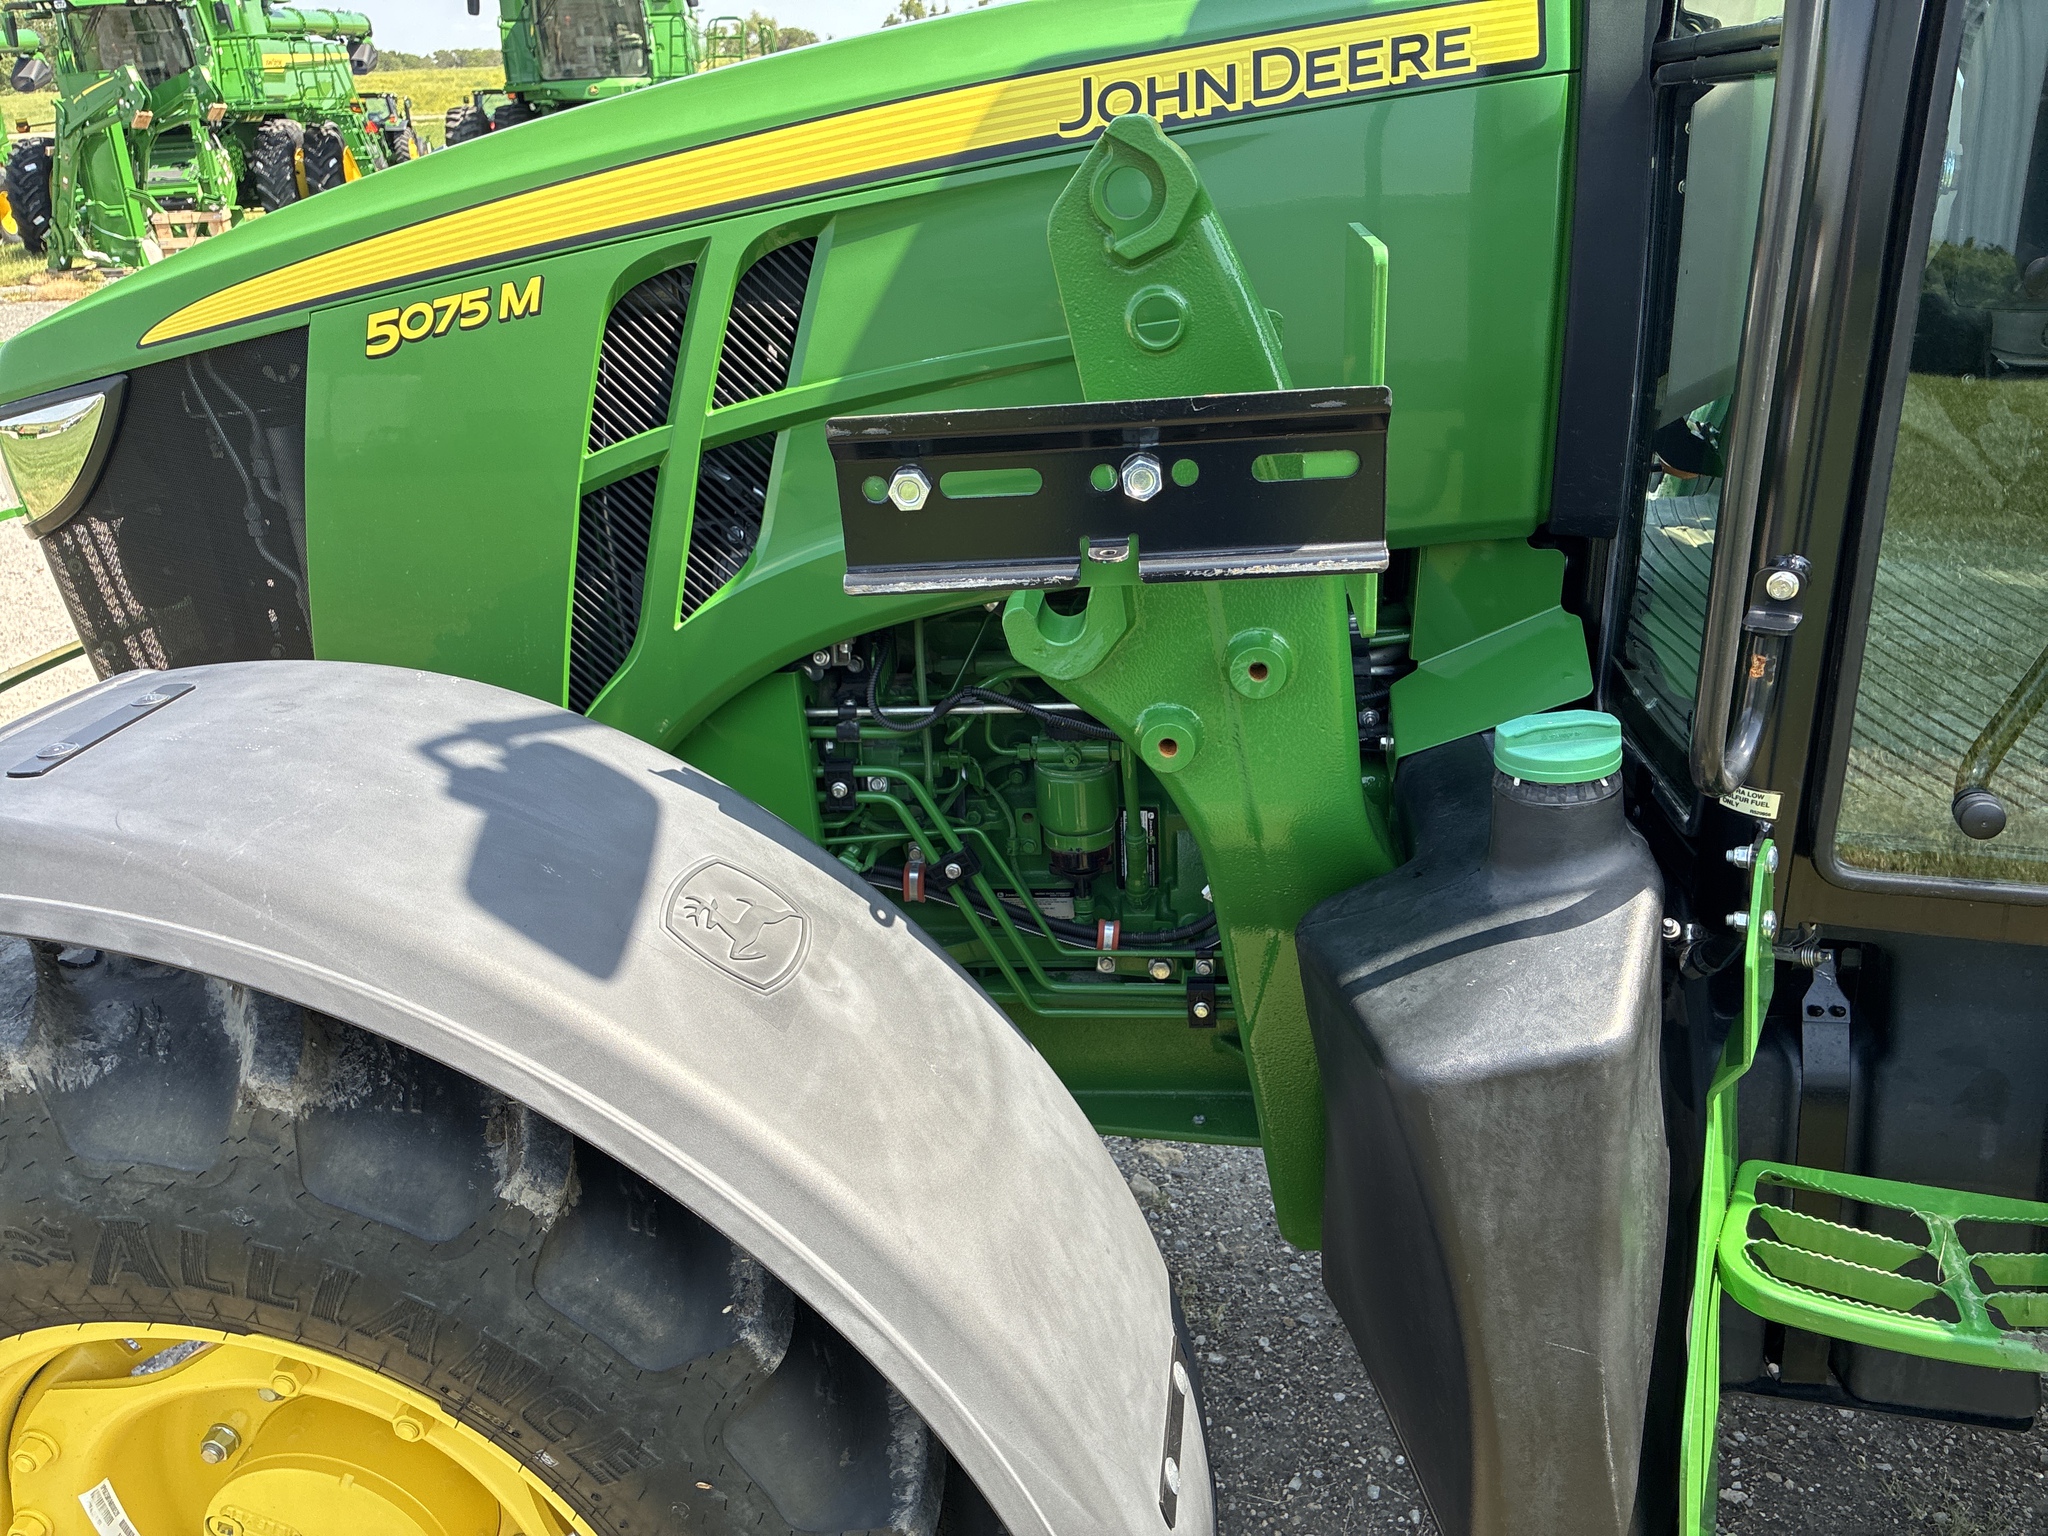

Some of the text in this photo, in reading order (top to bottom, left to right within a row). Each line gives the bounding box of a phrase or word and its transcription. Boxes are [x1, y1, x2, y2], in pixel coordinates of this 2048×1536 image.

[1058, 26, 1472, 132] JOHN DEERE
[366, 275, 546, 360] 5075 M
[1722, 797, 1740, 807] ONLY
[1747, 792, 1765, 800] LOW
[1750, 799, 1770, 808] FUEL
[88, 1216, 663, 1486] ALLIANCE
